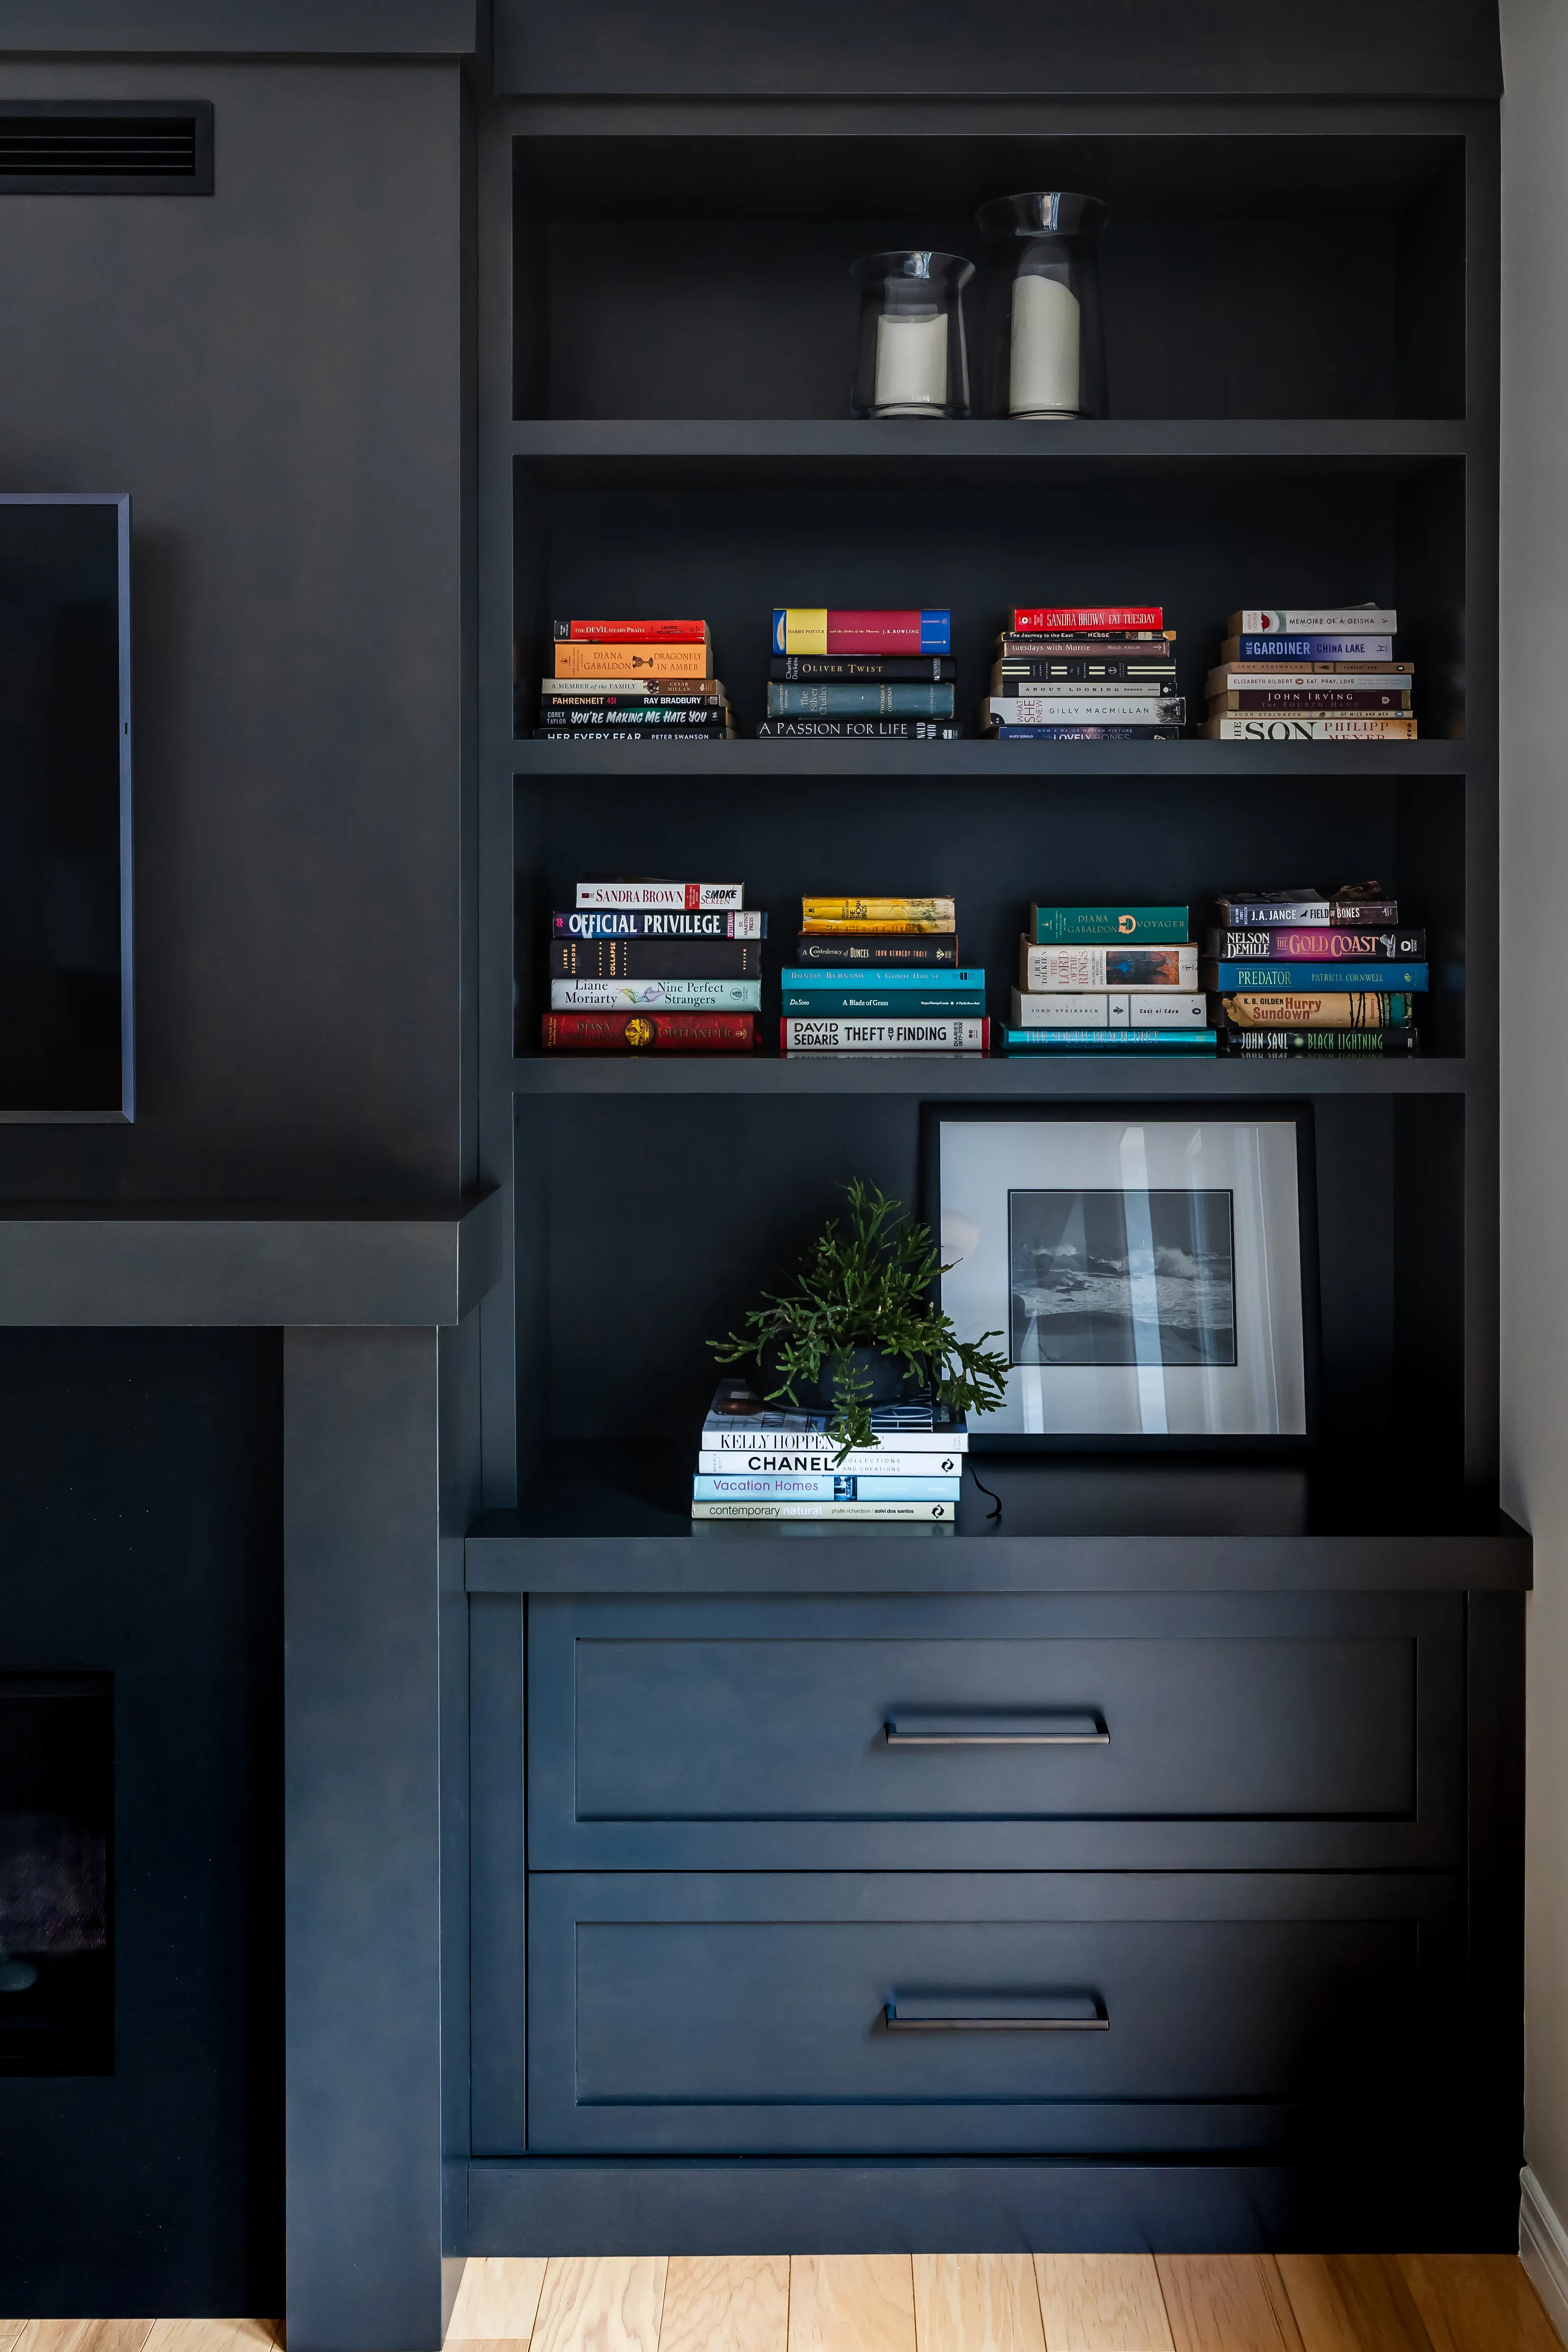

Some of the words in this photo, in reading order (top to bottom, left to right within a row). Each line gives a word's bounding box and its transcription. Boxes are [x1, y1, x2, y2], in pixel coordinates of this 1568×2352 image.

[1109, 615, 1122, 624] FAT
[1124, 614, 1155, 624] TUESDAY
[1254, 643, 1310, 654] GARDINER
[1317, 644, 1342, 652] CHINA
[1345, 644, 1365, 652] LAKE
[802, 664, 842, 673] OLIVER
[848, 664, 883, 673] TWIST
[800, 691, 808, 707] The
[1268, 693, 1299, 701] JOHN
[571, 711, 603, 724] YOU'RE
[606, 712, 643, 723] MAKING
[645, 711, 660, 722] ME
[663, 711, 687, 723] HATE
[688, 711, 707, 722] YOU
[1024, 700, 1035, 723] SHE
[760, 723, 771, 734] A
[778, 723, 840, 734] PASSION
[847, 724, 873, 734] FOR
[880, 723, 907, 734] LIFE
[1245, 722, 1318, 739] SON
[1324, 723, 1388, 731] PHILIPP
[596, 889, 640, 902] SANDRA
[643, 890, 683, 903] BROWN
[701, 895, 730, 904] SCREEN
[706, 890, 737, 899] SMOKE
[1252, 911, 1267, 920] J.A.
[1269, 910, 1297, 920] JANCE
[1310, 910, 1329, 918] FIELD
[1337, 908, 1360, 918] BONES
[569, 914, 637, 933] OFFICIAL
[643, 915, 721, 933] PRIVILEGE
[1227, 933, 1269, 943] NELSON
[1227, 944, 1269, 958] DEMILLE
[1277, 939, 1287, 948] THE
[1290, 935, 1328, 954] GOLD
[1331, 936, 1379, 956] COAST
[810, 946, 843, 957] Confederacy
[851, 947, 869, 958] DUNCES
[1059, 951, 1069, 984] LORD
[1079, 951, 1088, 984] RINGS
[1238, 971, 1291, 984] PREDATOR
[575, 980, 608, 990] Liane
[657, 982, 683, 992] Nine
[688, 982, 724, 992] Perfect
[565, 992, 617, 1007] Moriarty
[665, 994, 715, 1007] Strangers
[1285, 998, 1321, 1012] Hurry
[1253, 1007, 1310, 1020] Sundown
[659, 1028, 731, 1038] OUTLANDER
[794, 1023, 838, 1032] DAVID
[845, 1027, 885, 1040] THEFT
[897, 1027, 946, 1040] FINDING
[794, 1034, 838, 1045] SEDARIS
[1025, 1031, 1048, 1043] THE
[1052, 1031, 1089, 1043] SOUTH
[1093, 1031, 1128, 1043] BEACH
[1134, 1031, 1159, 1043] DIET
[1241, 1033, 1263, 1049] JOHN
[1268, 1033, 1287, 1049] SAUL
[1308, 1034, 1333, 1049] BLACK
[1339, 1034, 1383, 1050] LIGHTNING
[721, 1435, 766, 1449] KELLY
[774, 1435, 834, 1449] HOPPEN
[748, 1457, 834, 1471] CHANEL
[714, 1480, 770, 1490] Vacation
[776, 1481, 818, 1490] Homes
[710, 1506, 780, 1517] contemporary
[783, 1506, 822, 1515] natural
